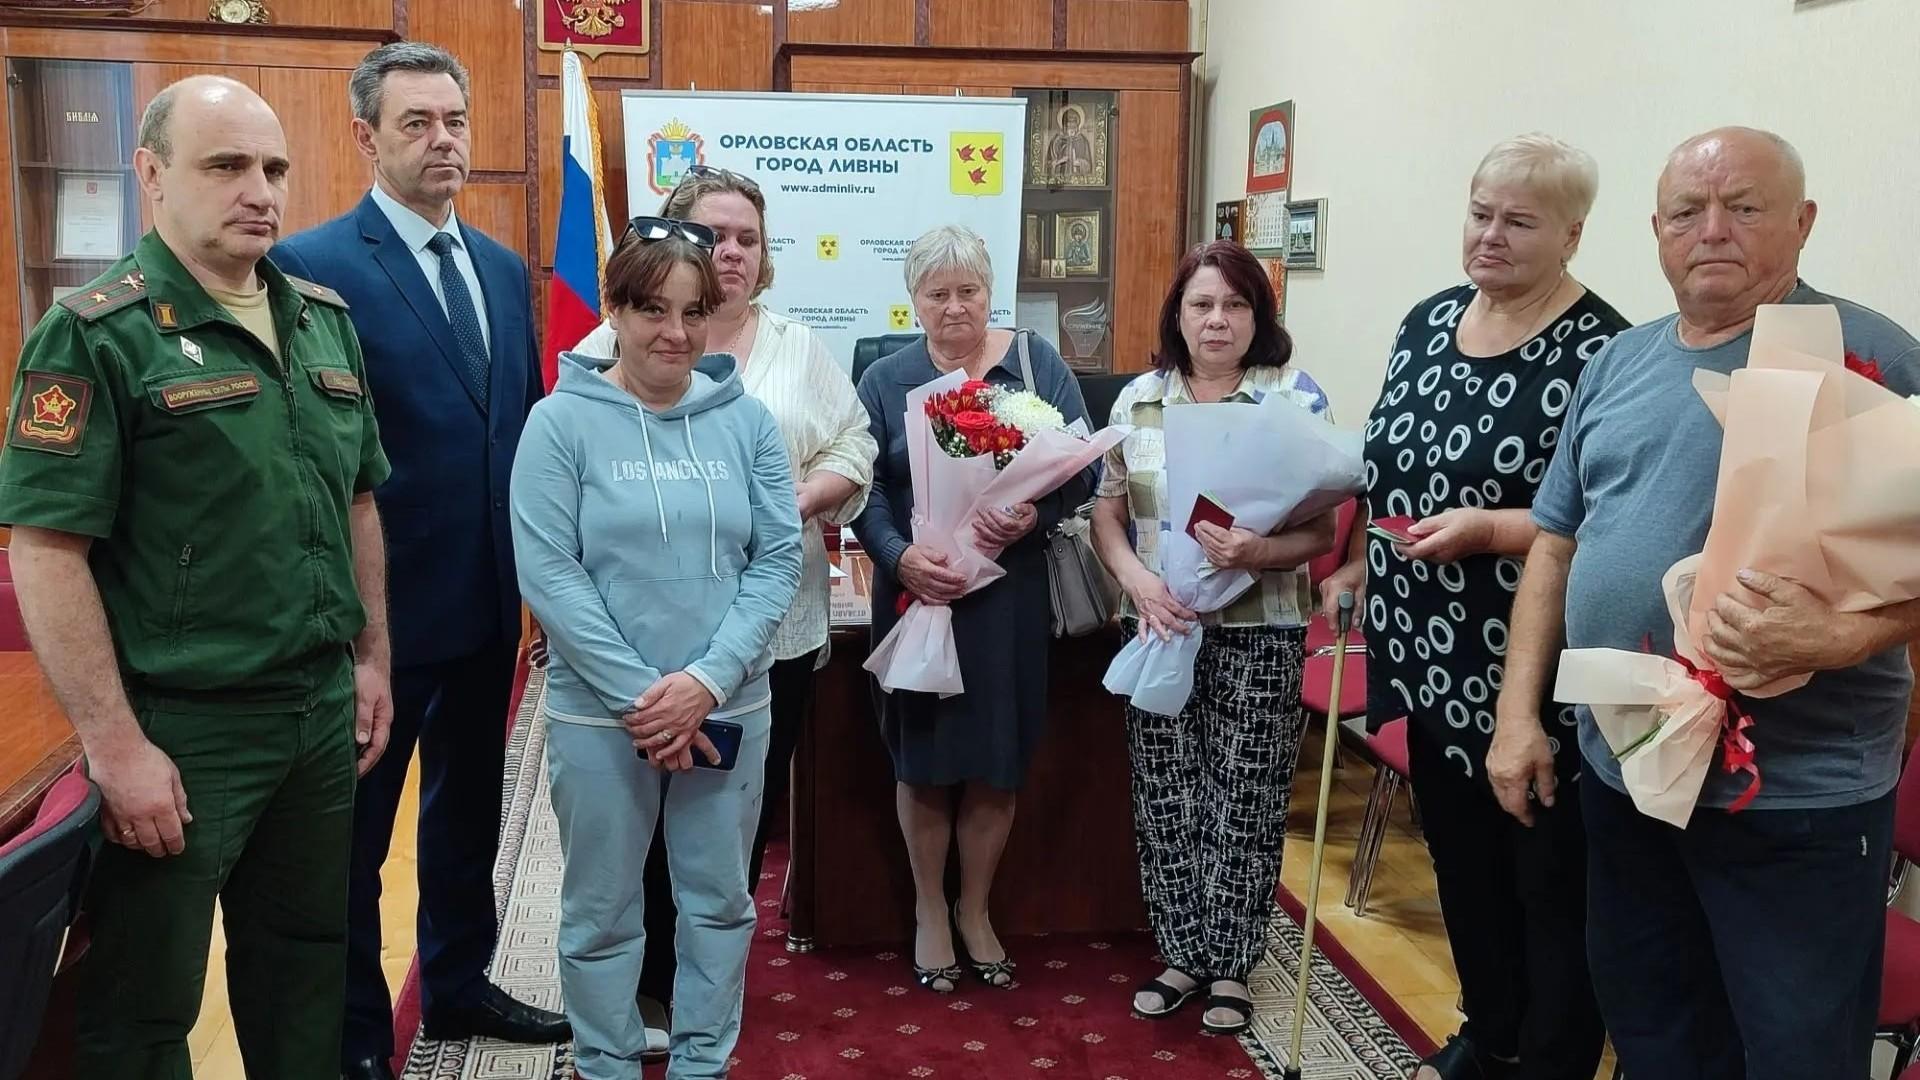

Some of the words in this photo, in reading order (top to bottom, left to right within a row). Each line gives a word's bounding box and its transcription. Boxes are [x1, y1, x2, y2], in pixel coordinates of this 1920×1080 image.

[719, 134, 838, 151] ОРЛОВСКАЯ
[844, 137, 934, 153] ОБЛАСТЬ
[755, 157, 823, 175] ГОРОД
[828, 158, 899, 174] ЛИВНЫ
[780, 183, 876, 194] www.adminliv.ru
[834, 307, 869, 315] ОБЛАСТЬ
[801, 315, 827, 323] ГОРОД
[611, 459, 648, 481] LOS
